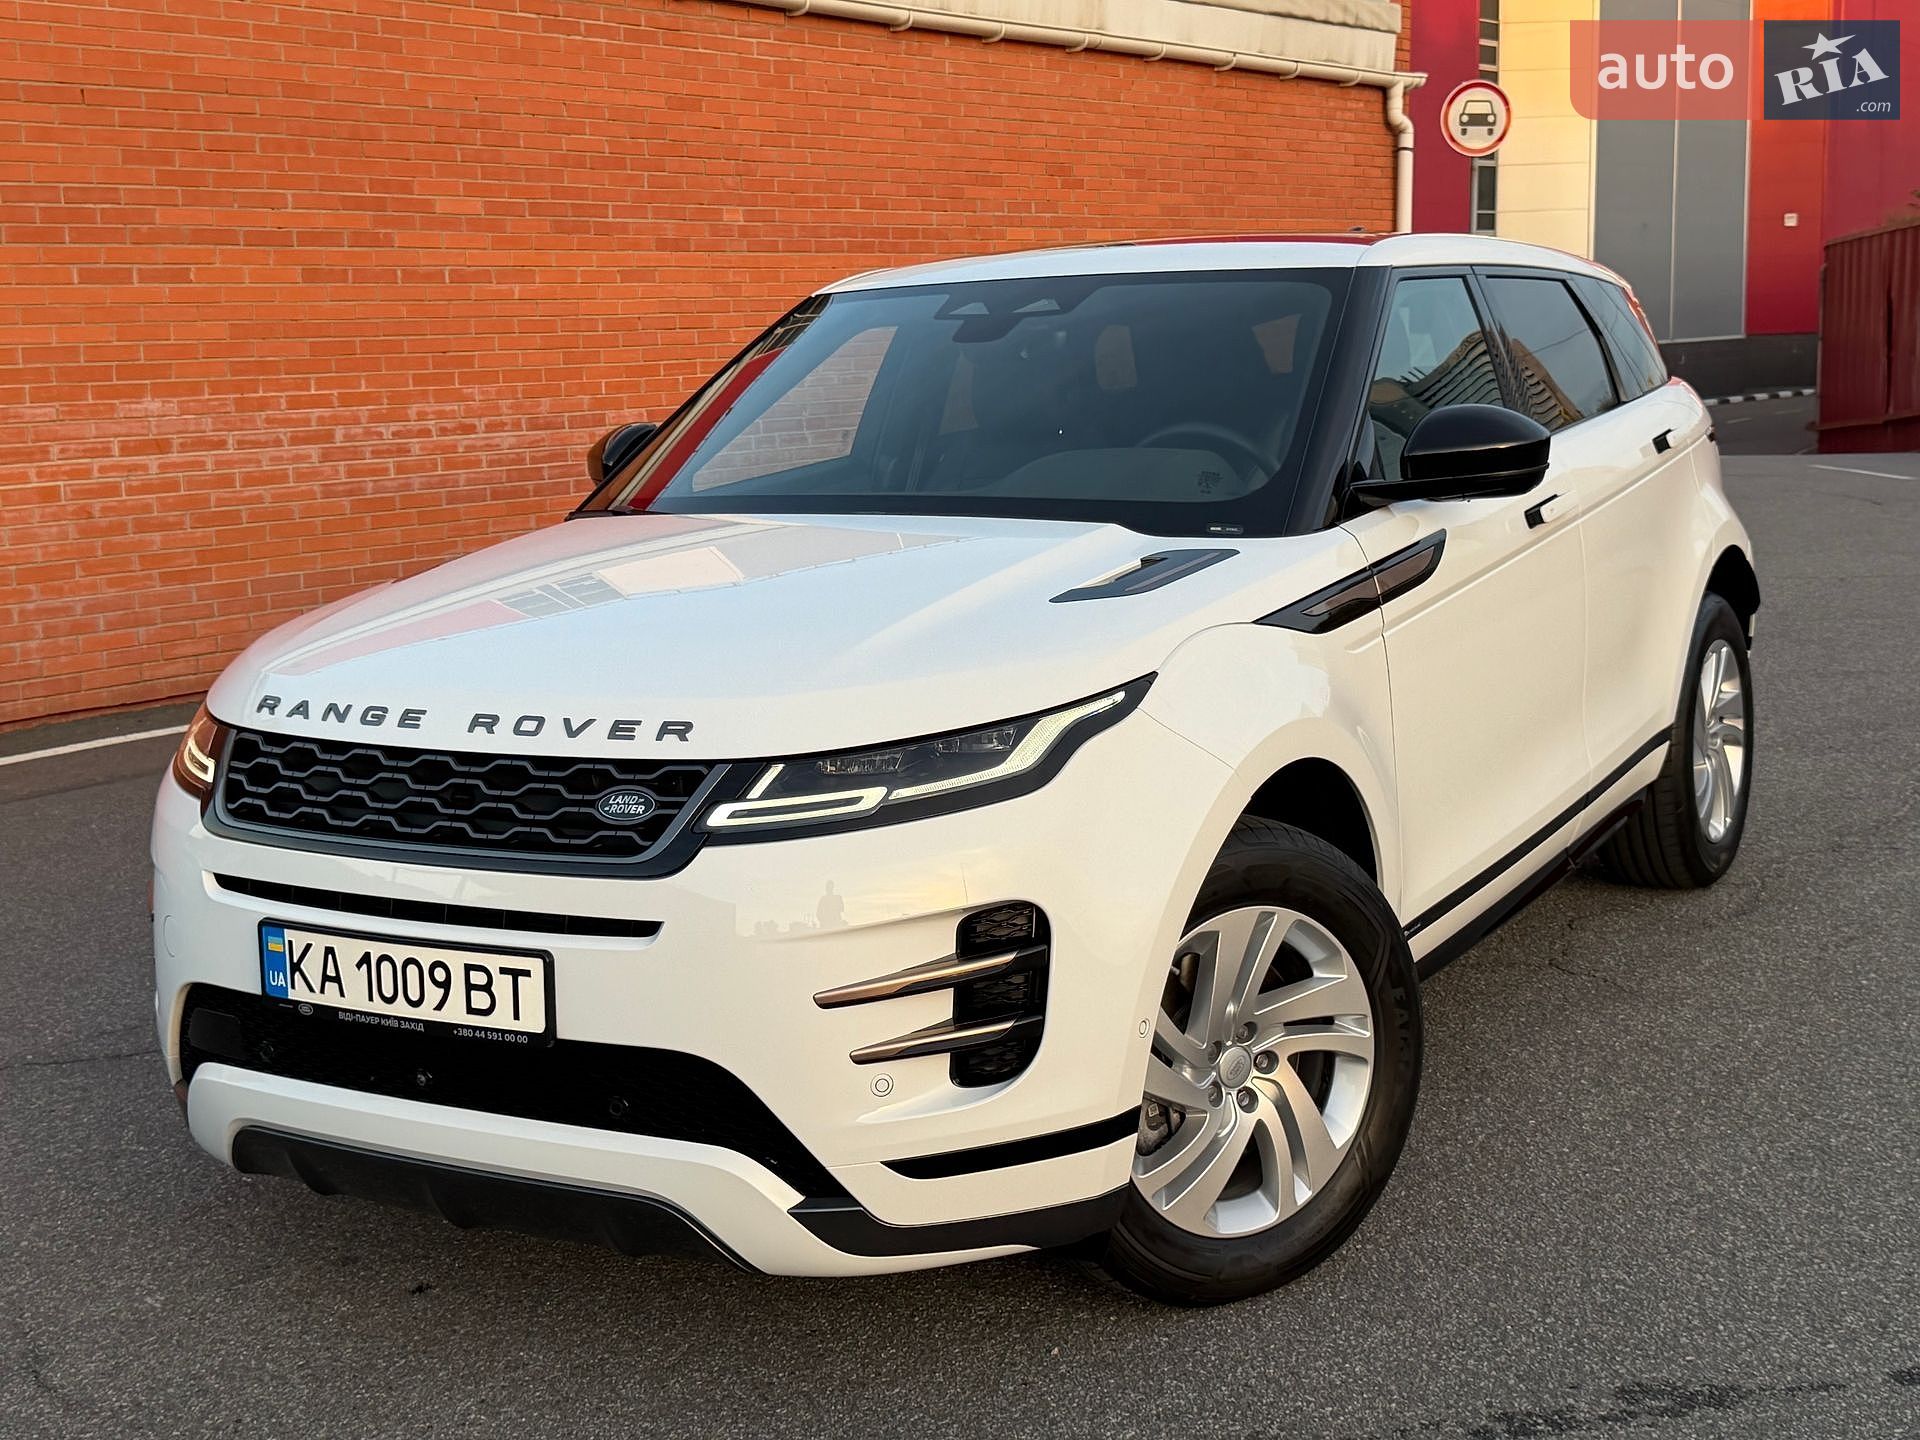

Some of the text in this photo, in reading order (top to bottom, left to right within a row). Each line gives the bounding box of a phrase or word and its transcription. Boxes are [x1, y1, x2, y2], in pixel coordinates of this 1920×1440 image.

[256, 694, 695, 742] RANGE ROVER
[608, 795, 639, 804] LAND
[608, 804, 645, 814] ROVER
[269, 970, 287, 987] UA
[288, 939, 532, 1021] KA 1009 BT
[453, 1028, 528, 1044] +380 44 591 00 00
